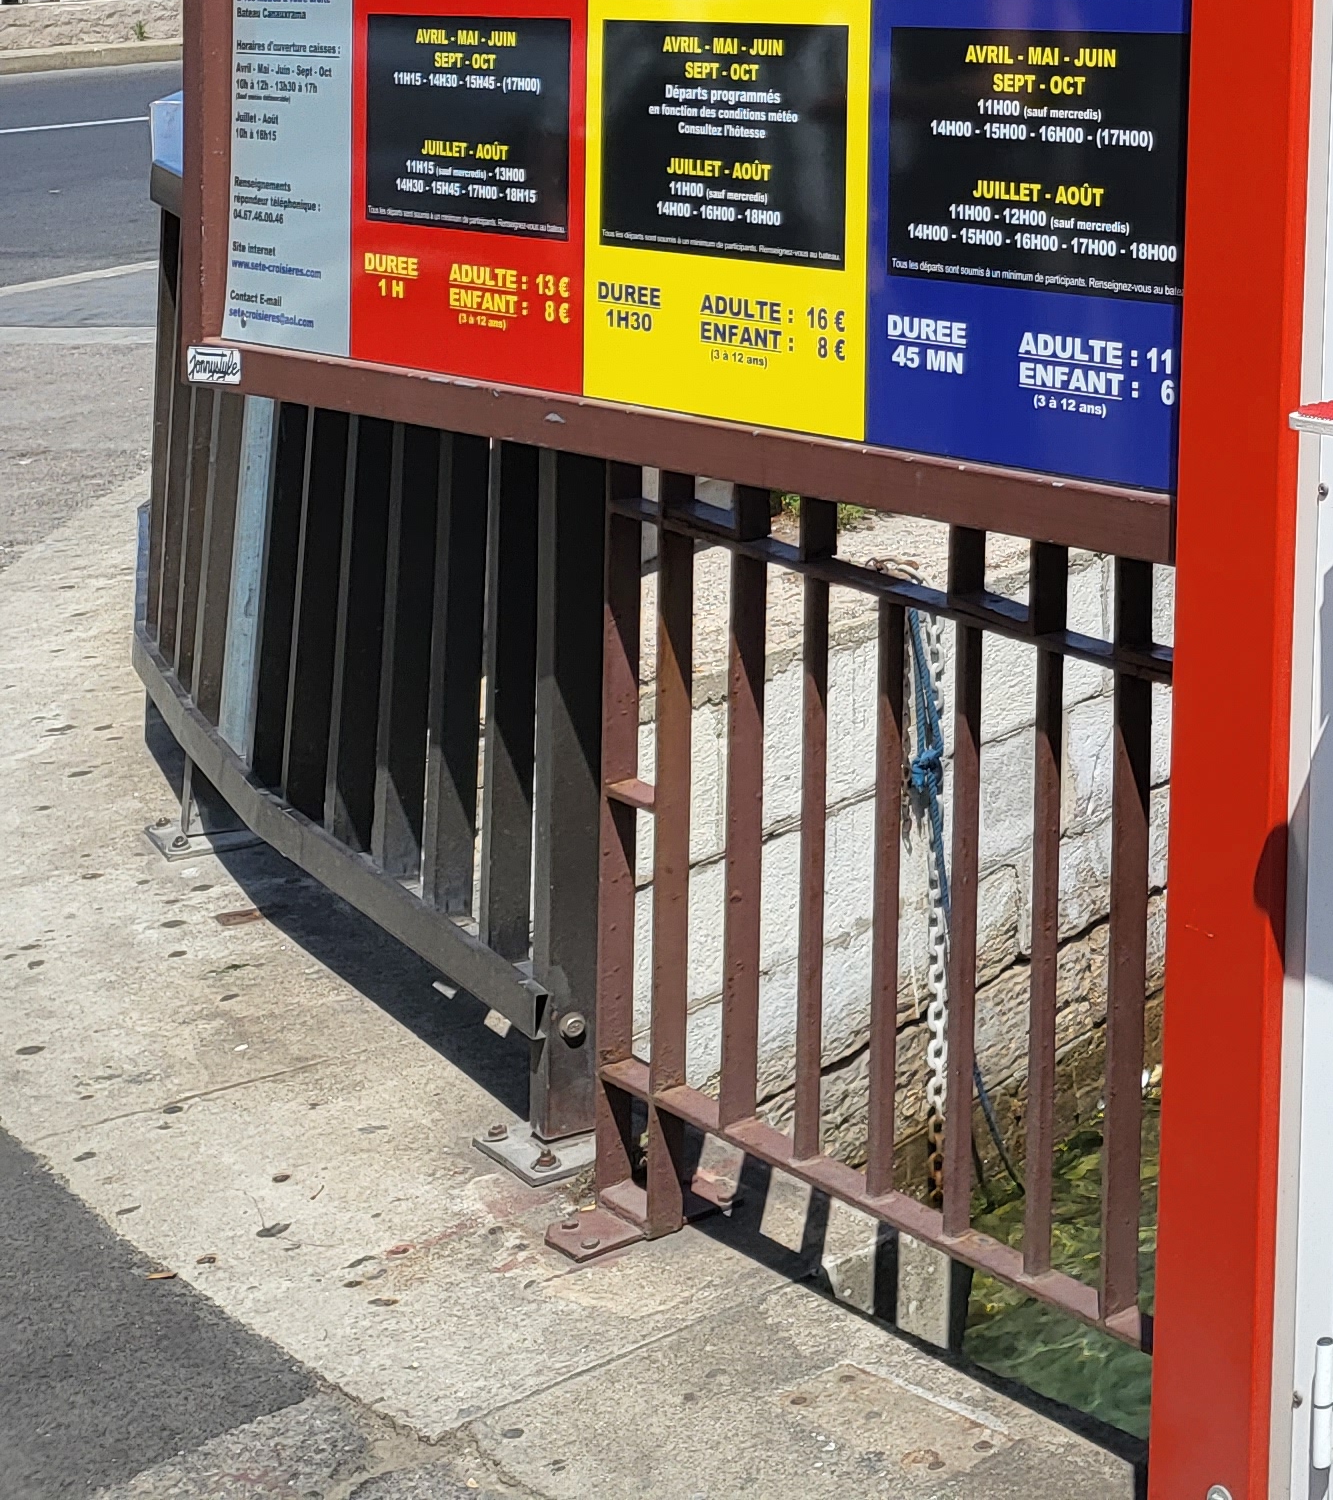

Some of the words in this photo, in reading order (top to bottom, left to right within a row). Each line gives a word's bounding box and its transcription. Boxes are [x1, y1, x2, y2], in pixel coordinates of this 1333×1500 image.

[965, 45, 1013, 65] AVRIL
[1028, 47, 1059, 66] MAI
[1074, 48, 1116, 67] JUIN
[993, 74, 1035, 93] SEPT
[1050, 76, 1086, 96] OCT
[667, 158, 721, 178] JUILLET
[732, 160, 771, 181] AOÛT
[364, 252, 418, 275] DUREE
[378, 279, 386, 297] 1
[391, 281, 404, 298] H
[598, 282, 661, 306] DUREE
[606, 309, 652, 332] 1H30
[888, 315, 967, 343] DUREE
[892, 345, 920, 369] 45
[926, 348, 963, 374] MN
[1018, 332, 1123, 365] ADULTE
[1146, 347, 1173, 374] 11
[1019, 363, 1124, 396] ENFANT
[1160, 379, 1175, 405] 6
